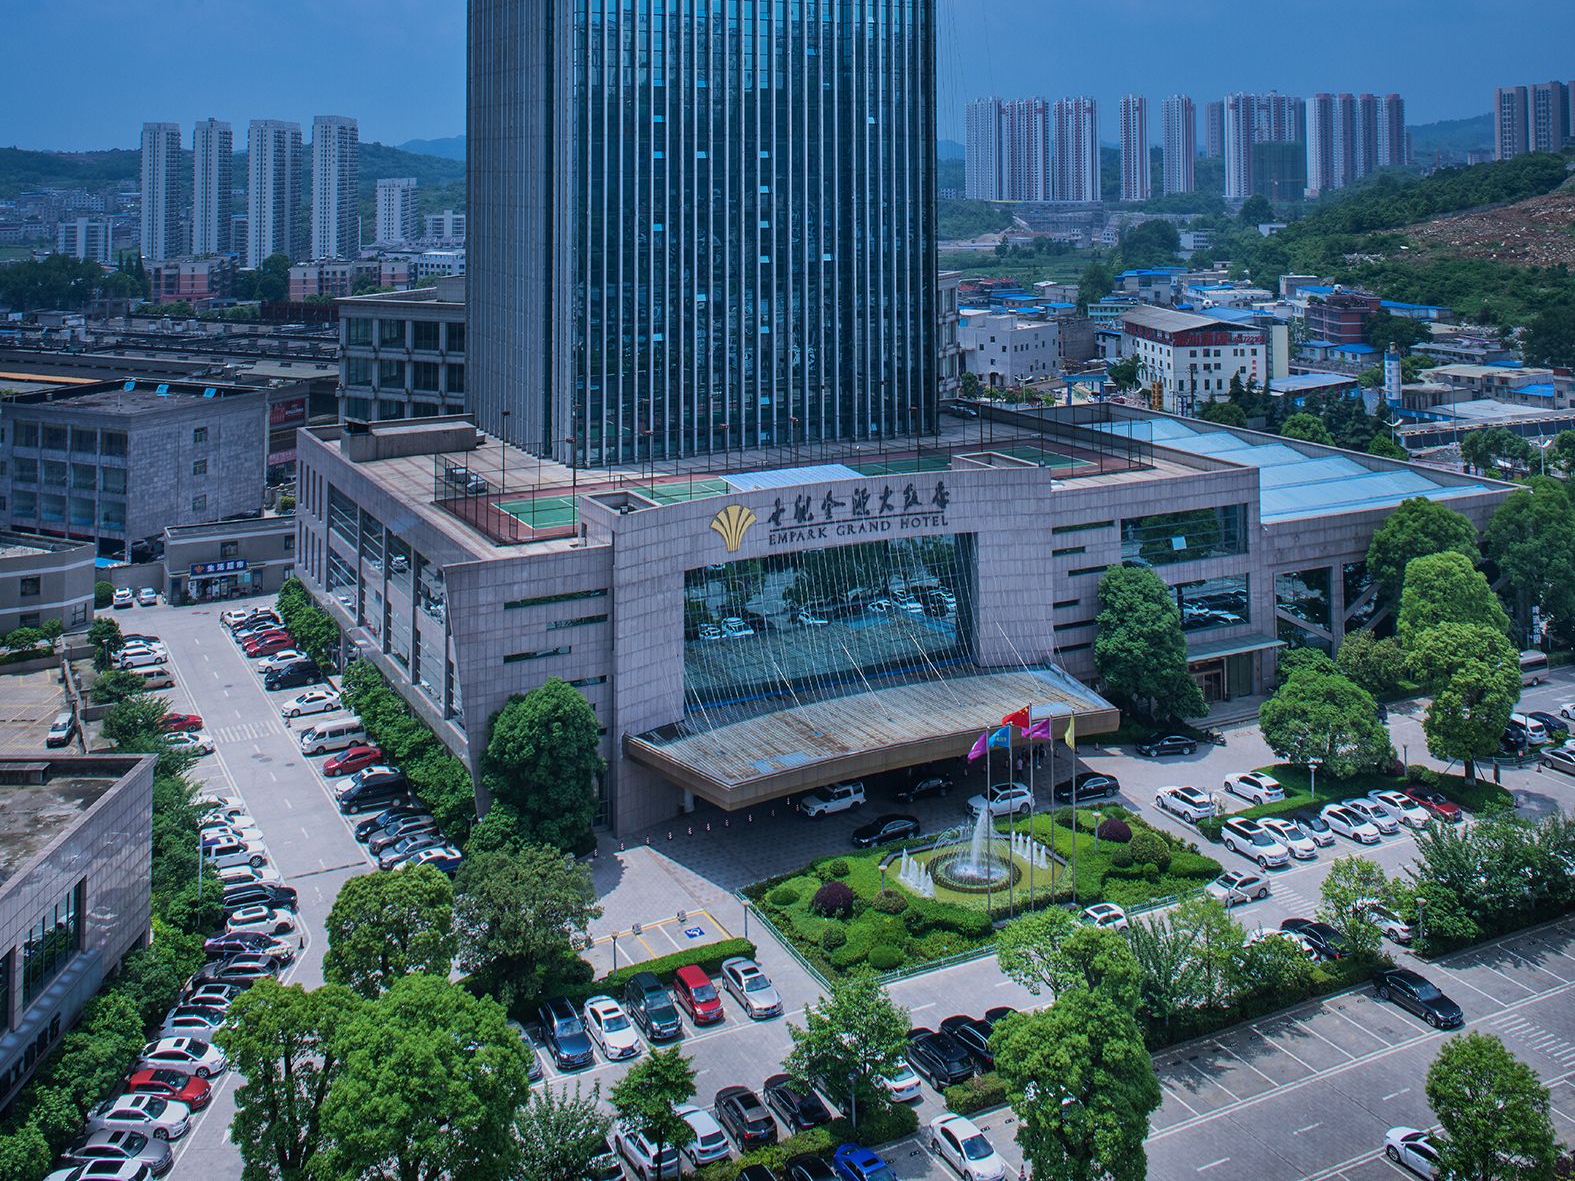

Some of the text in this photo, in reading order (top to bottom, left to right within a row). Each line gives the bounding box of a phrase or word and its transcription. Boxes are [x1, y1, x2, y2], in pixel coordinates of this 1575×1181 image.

[769, 514, 949, 546] EMPARK GRAND HOTEL
[207, 561, 244, 572] 生活超市
